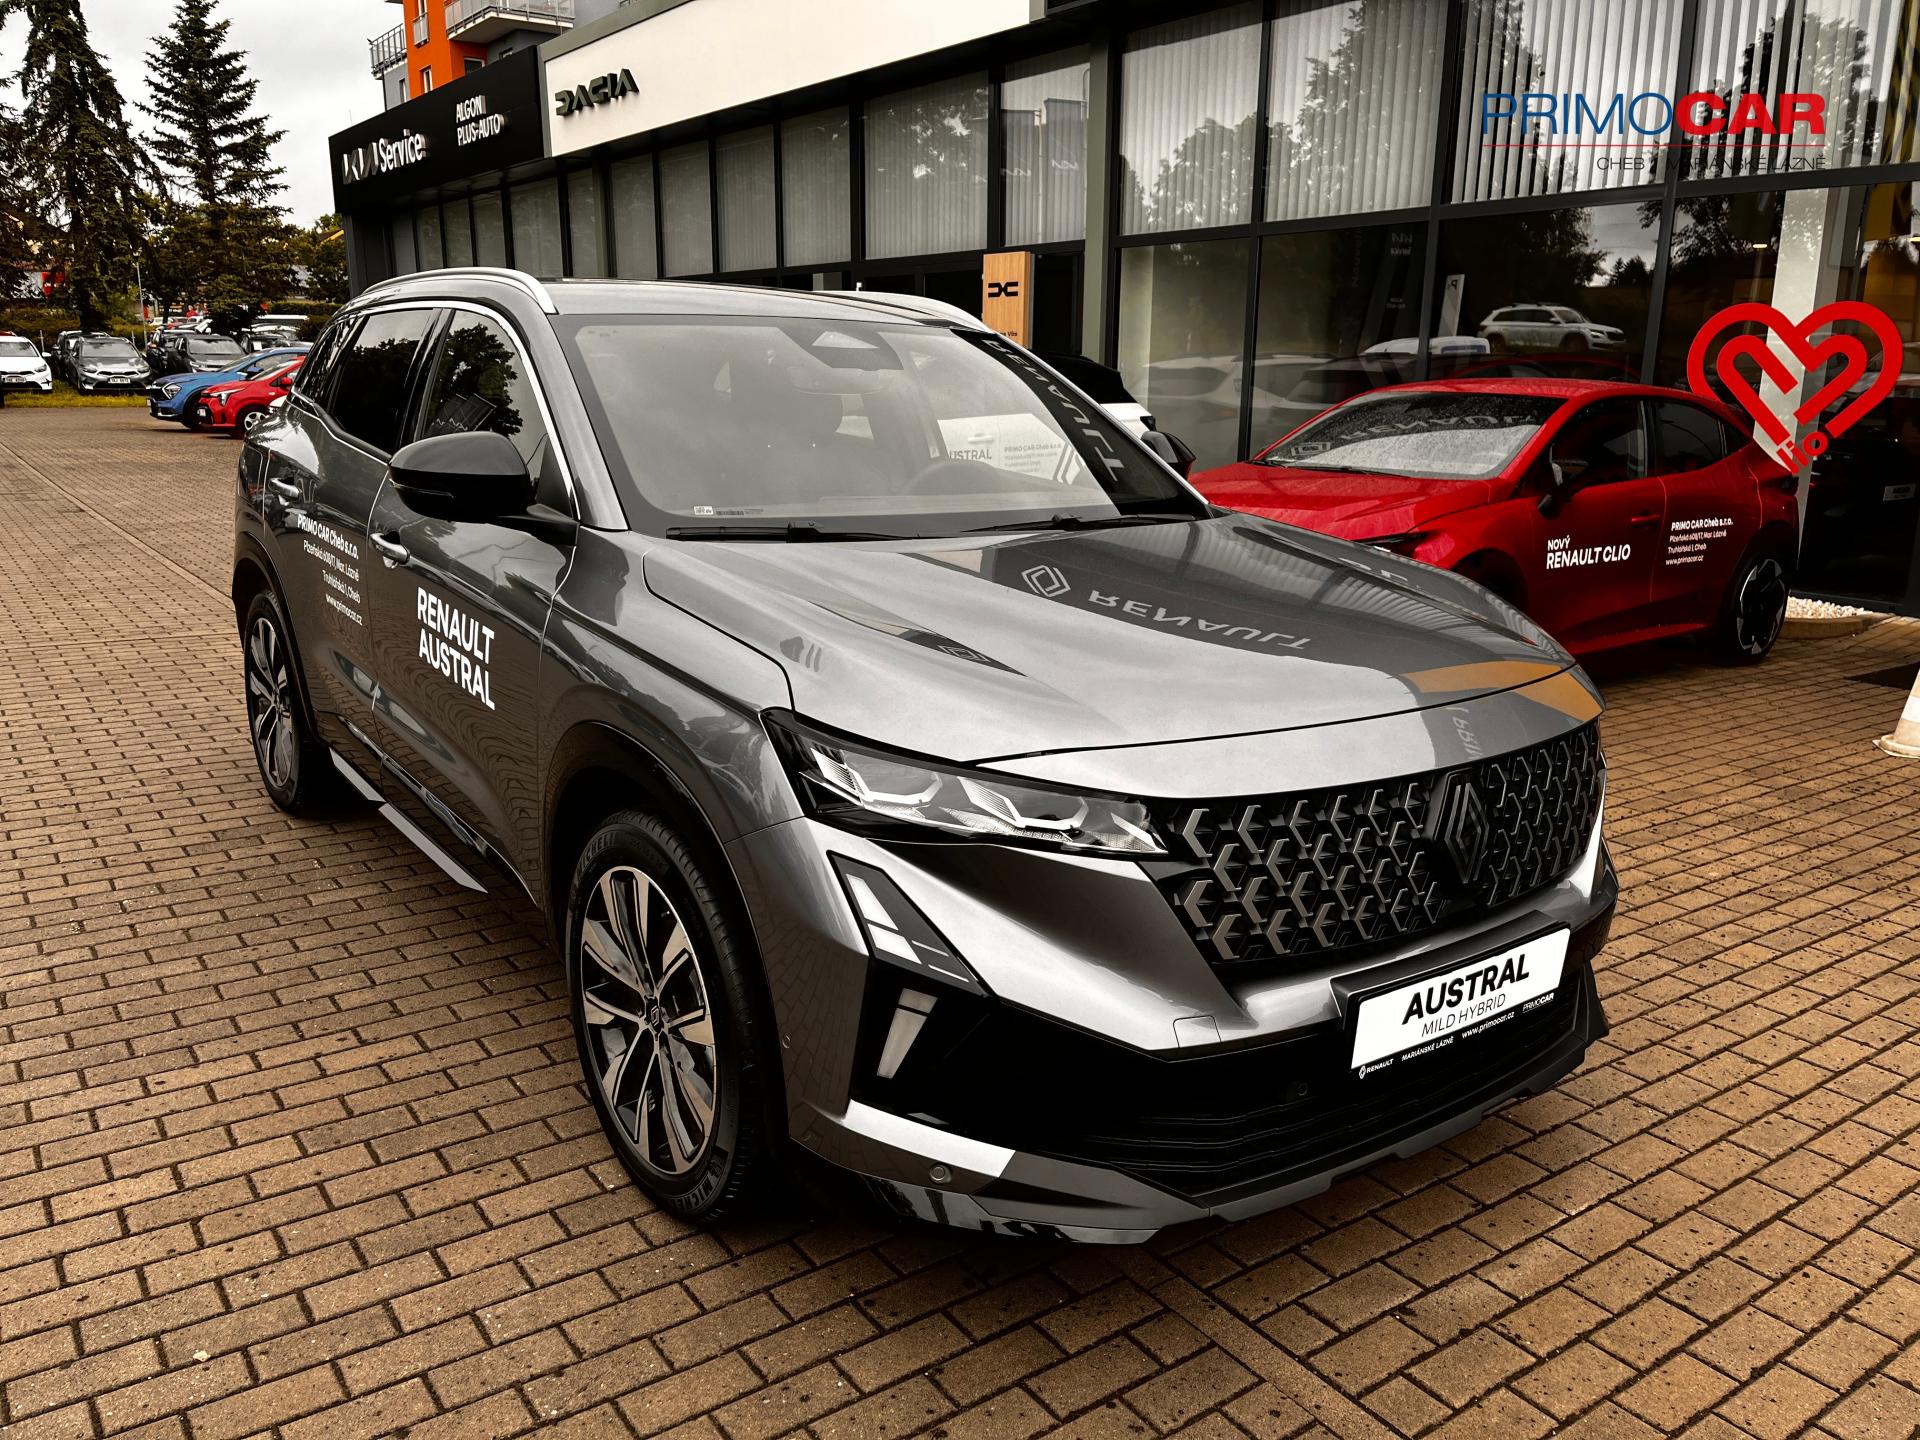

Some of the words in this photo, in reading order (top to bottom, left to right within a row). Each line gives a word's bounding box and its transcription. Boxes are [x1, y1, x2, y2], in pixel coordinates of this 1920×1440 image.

[456, 94, 486, 123] ALGON
[457, 113, 504, 146] PLUS-AUTO
[379, 129, 425, 173] Service
[298, 513, 318, 536] PRIMO
[317, 523, 330, 542] CAR
[330, 529, 344, 551] Cheb
[344, 540, 359, 560] s.r.o.
[1547, 535, 1570, 550] NOVÝ
[1671, 520, 1691, 531] PRIMO
[1691, 519, 1704, 529] CAR
[1704, 517, 1719, 527] Cheb
[1719, 518, 1734, 526] s.r.o.
[1546, 547, 1602, 570] RENAULT
[1602, 544, 1631, 563] CLIO
[417, 587, 495, 664] RENAULT
[419, 628, 495, 710] AUSTRAL
[1402, 954, 1530, 1025] AUSTRAL
[1366, 1058, 1394, 1073] RENAULT
[1401, 1042, 1436, 1061] MARIÁNSKÉ
[1435, 1035, 1454, 1049] LÁZNĚ
[1461, 1011, 1515, 1039] www.primocar.cz
[1522, 992, 1555, 1011] PRIMOCAR
[1421, 1013, 1456, 1038] MILD
[1458, 993, 1506, 1024] HYBRID
